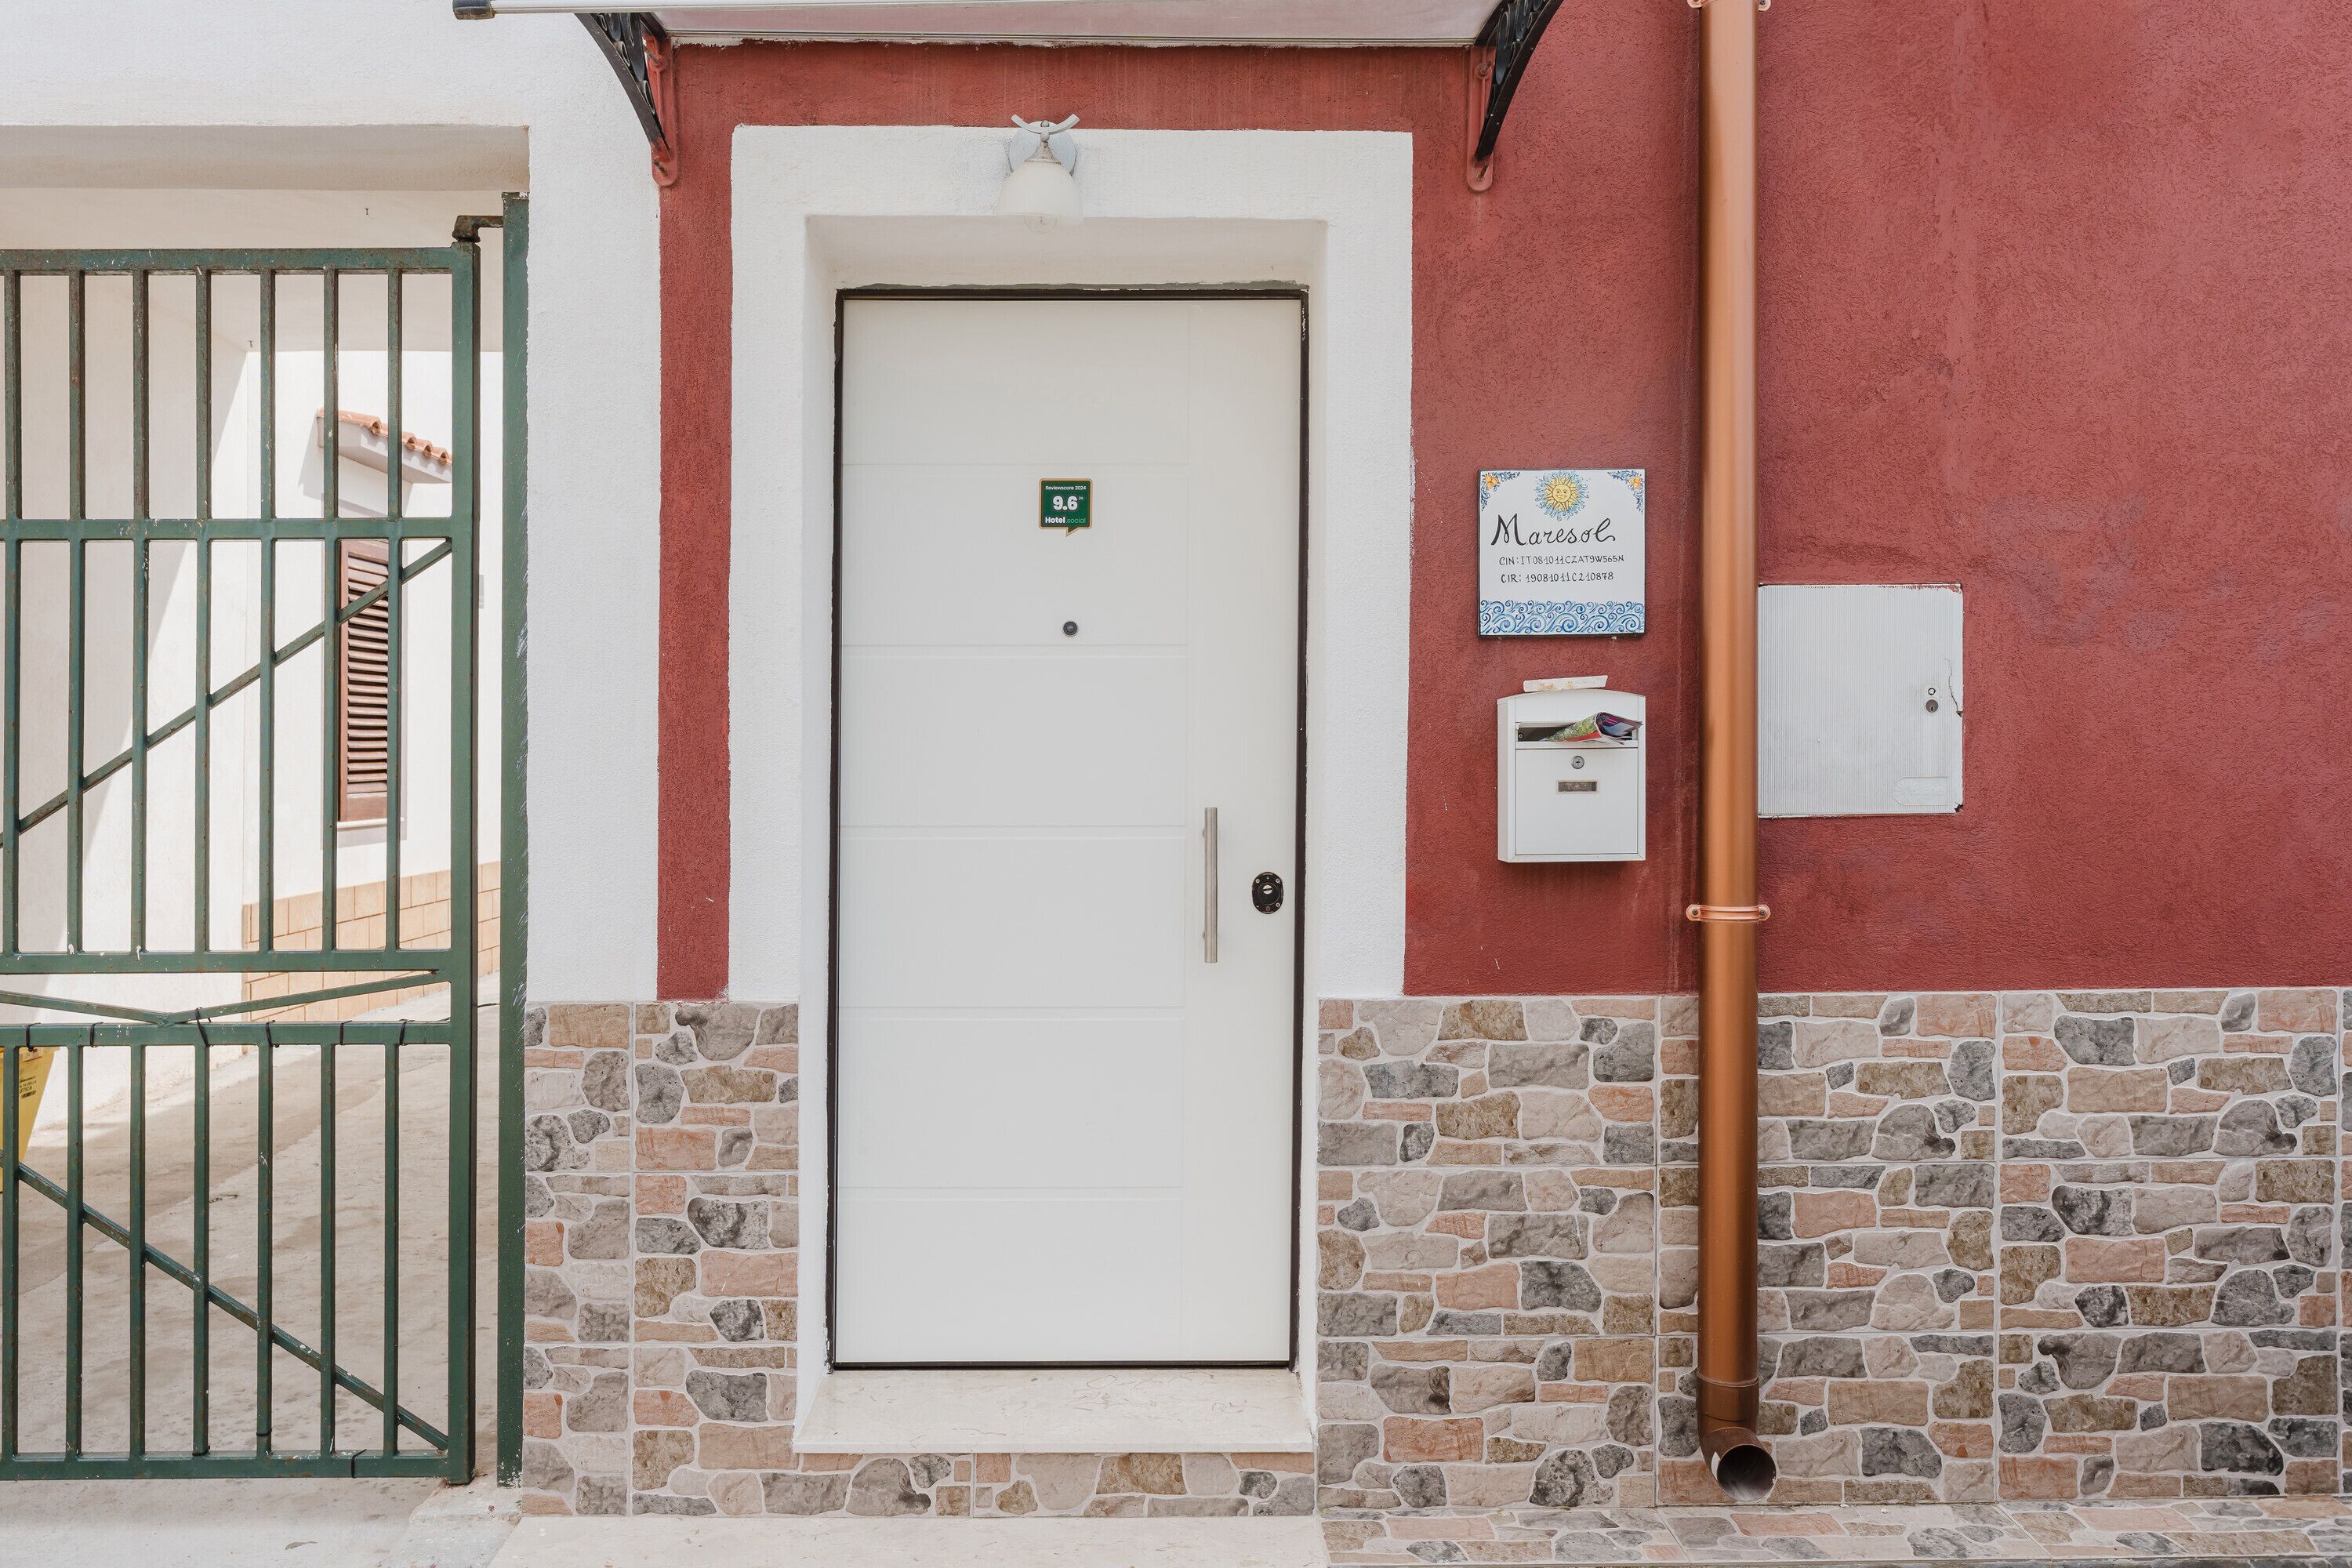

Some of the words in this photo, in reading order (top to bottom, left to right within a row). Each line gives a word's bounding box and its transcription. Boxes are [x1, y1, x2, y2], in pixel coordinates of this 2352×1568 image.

[1053, 495, 1078, 510] 9.6
[1490, 513, 1616, 546] Maresol
[1501, 573, 1522, 583] CIR:
[1525, 572, 1613, 583] 19081011C210878
